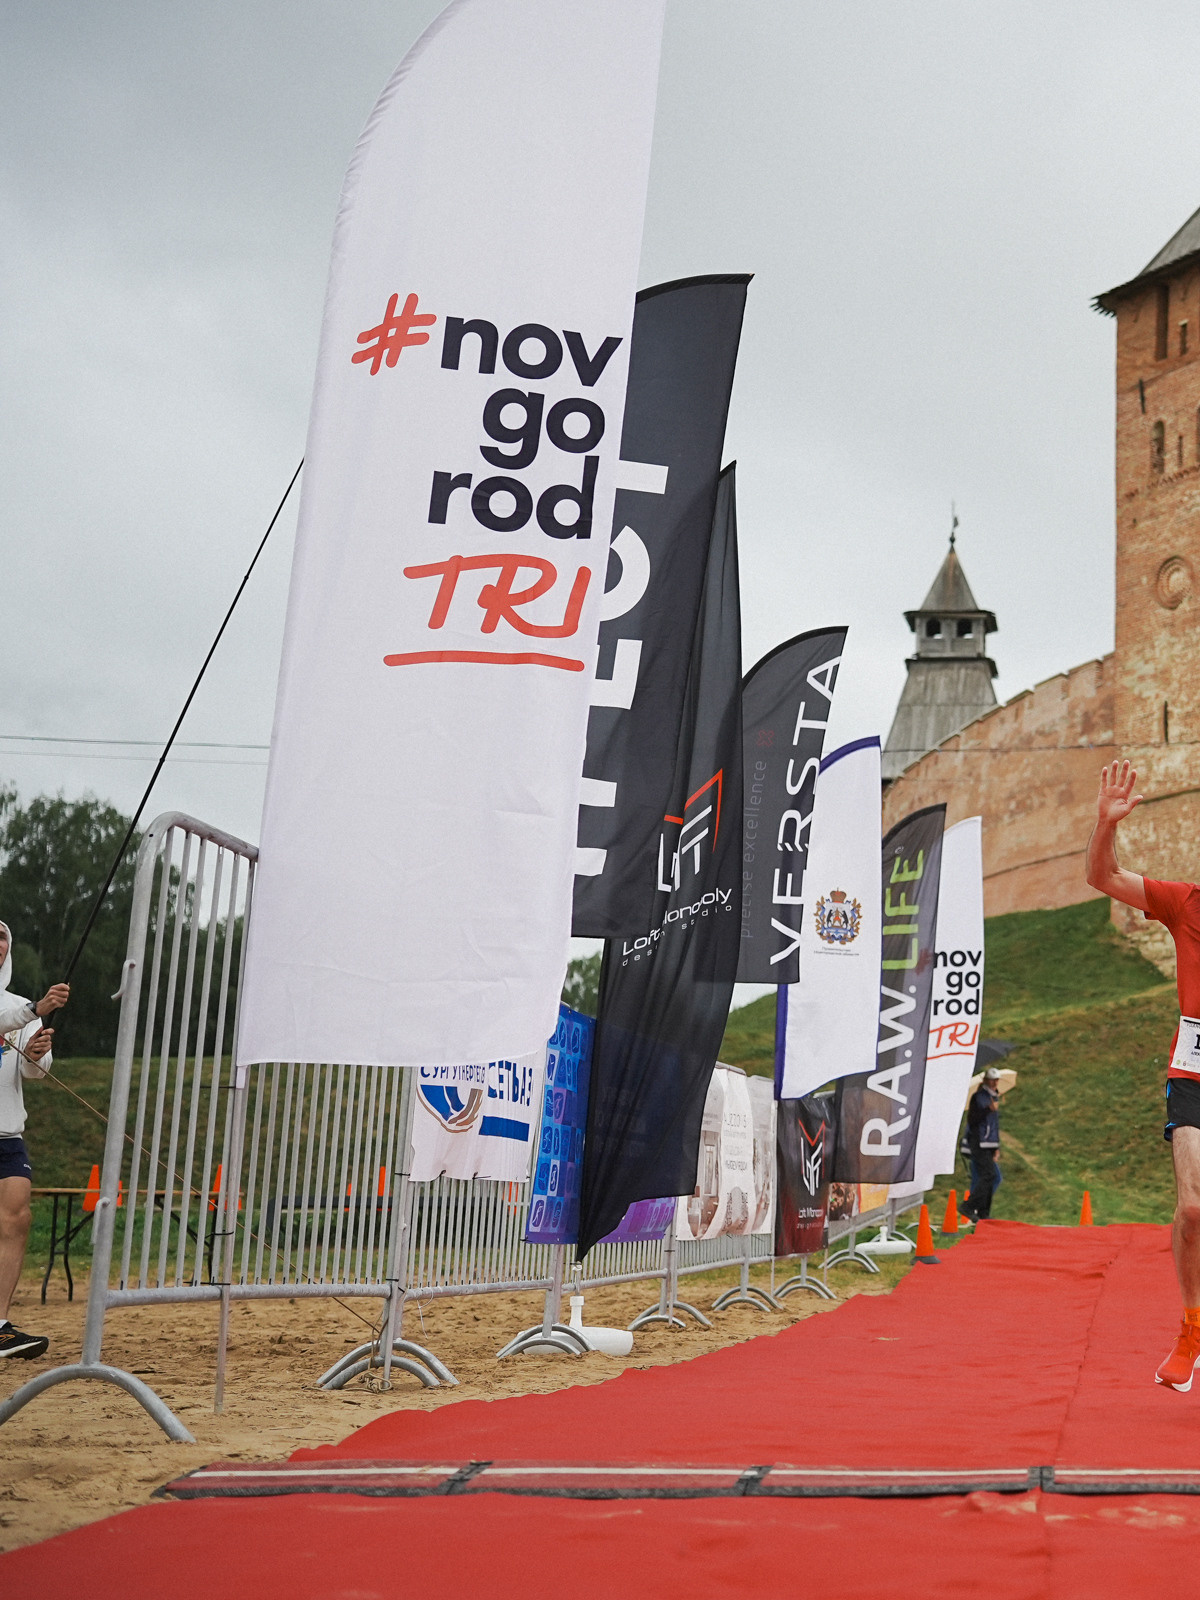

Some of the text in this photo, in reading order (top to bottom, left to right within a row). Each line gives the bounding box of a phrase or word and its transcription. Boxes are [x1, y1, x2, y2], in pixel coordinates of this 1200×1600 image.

[351, 293, 622, 387] #nov
[479, 387, 605, 470] go
[427, 455, 600, 540] rod
[403, 554, 592, 639] TRI
[743, 760, 767, 863] excellence
[770, 655, 842, 965] VERSTA
[881, 849, 924, 970] LIFE
[918, 949, 982, 968] nov
[946, 971, 981, 996] go
[929, 1022, 979, 1048] TRI
[933, 989, 980, 1016] rod
